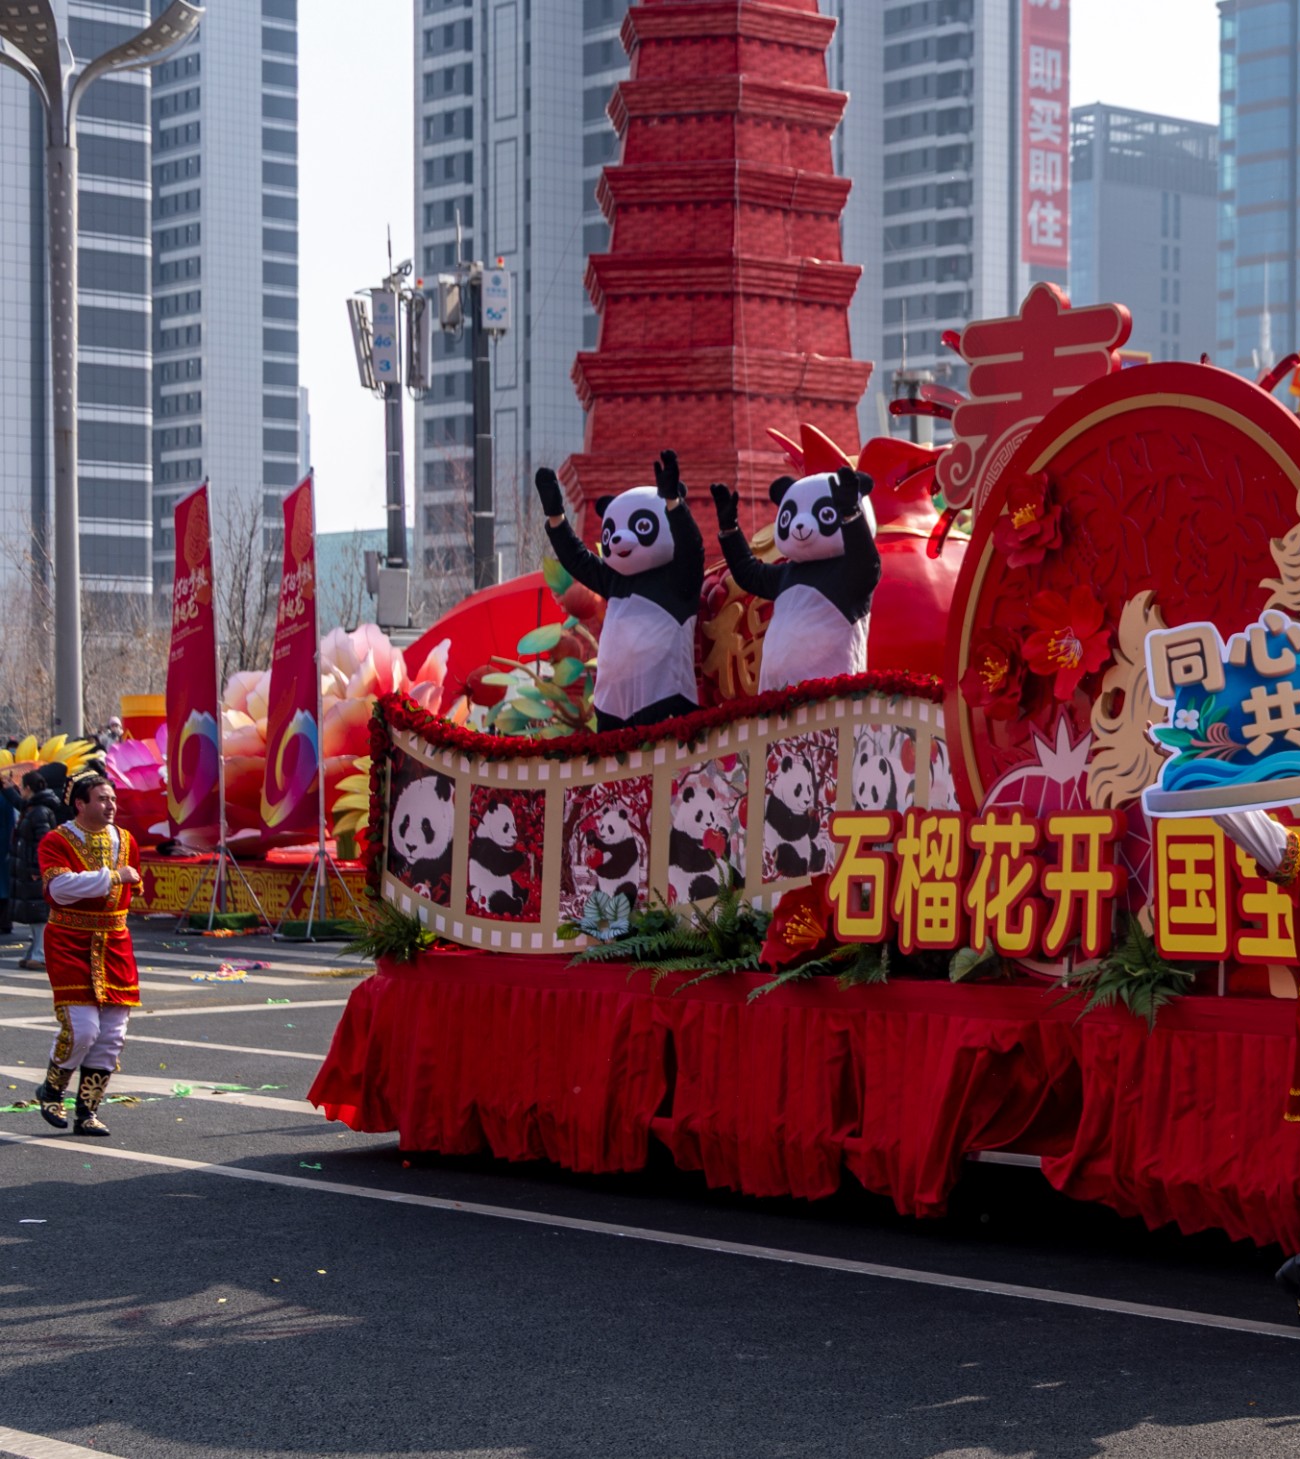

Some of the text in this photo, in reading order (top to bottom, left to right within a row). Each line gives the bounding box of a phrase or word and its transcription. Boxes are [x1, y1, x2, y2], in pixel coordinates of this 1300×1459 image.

[1028, 44, 1062, 247] 即买即住
[379, 359, 391, 373] 3
[828, 810, 1116, 956] 石榴花开
